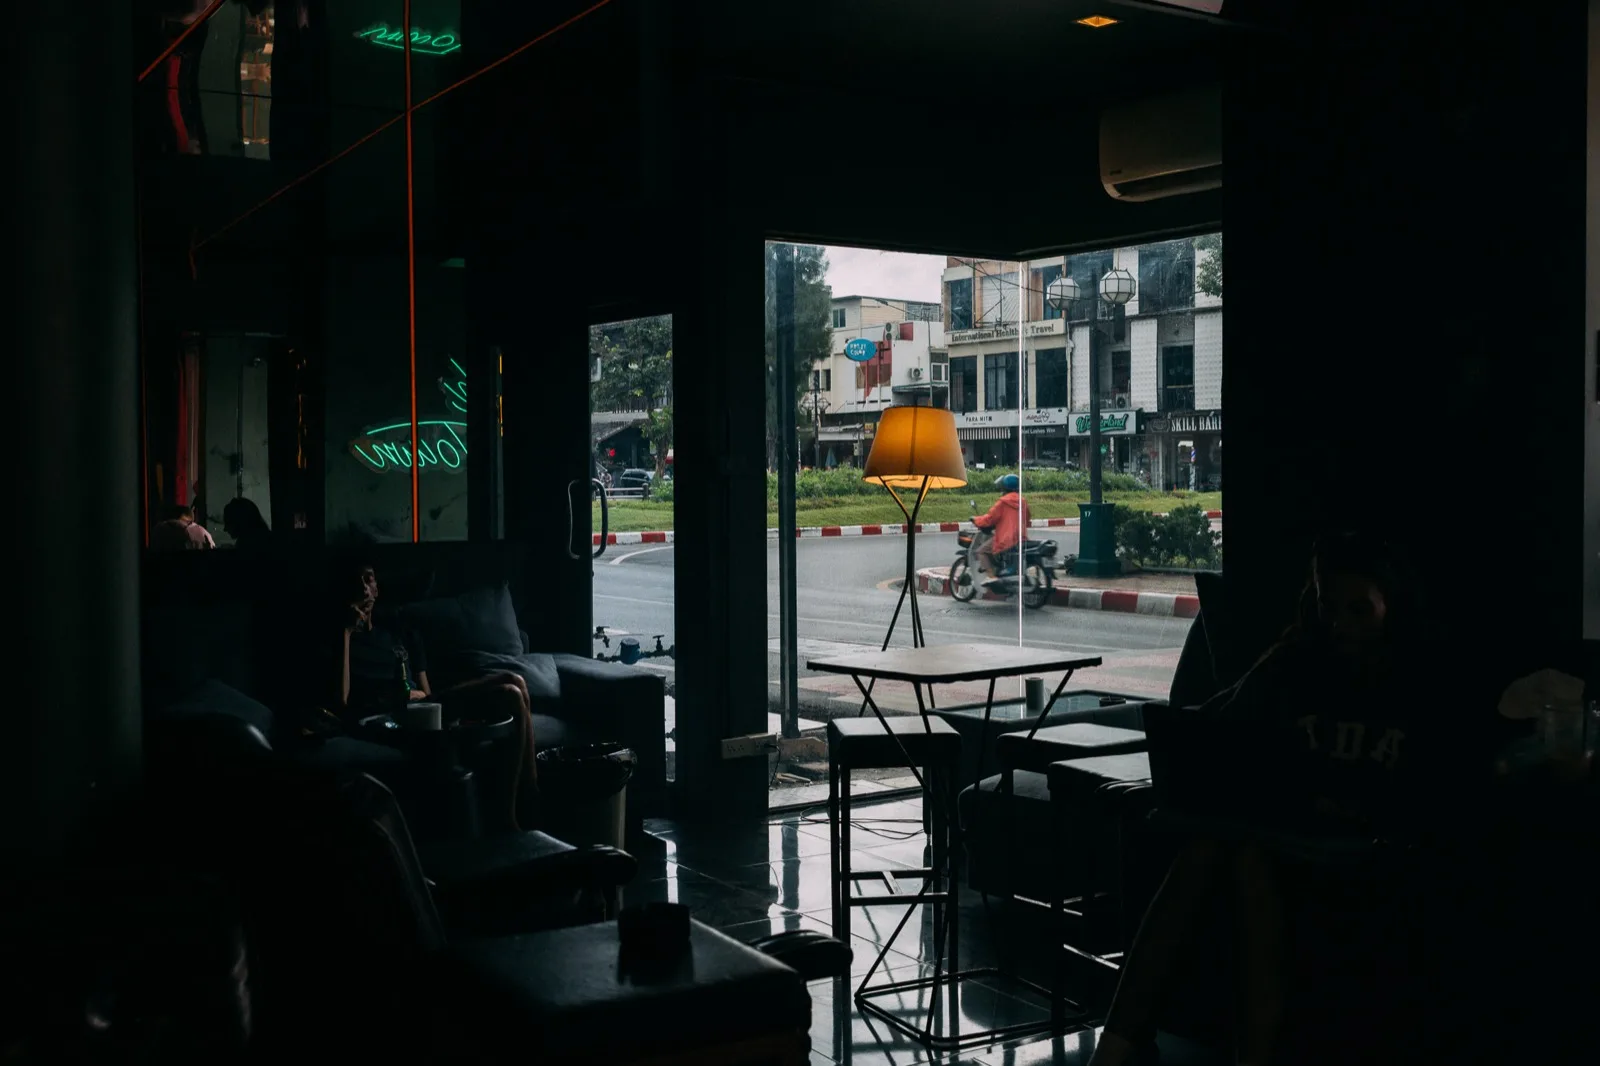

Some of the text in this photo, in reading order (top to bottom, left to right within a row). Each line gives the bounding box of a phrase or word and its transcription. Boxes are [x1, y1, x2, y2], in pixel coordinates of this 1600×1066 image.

[952, 331, 994, 342] International
[1031, 324, 1054, 333] Travel
[1171, 417, 1197, 432] SKILL
